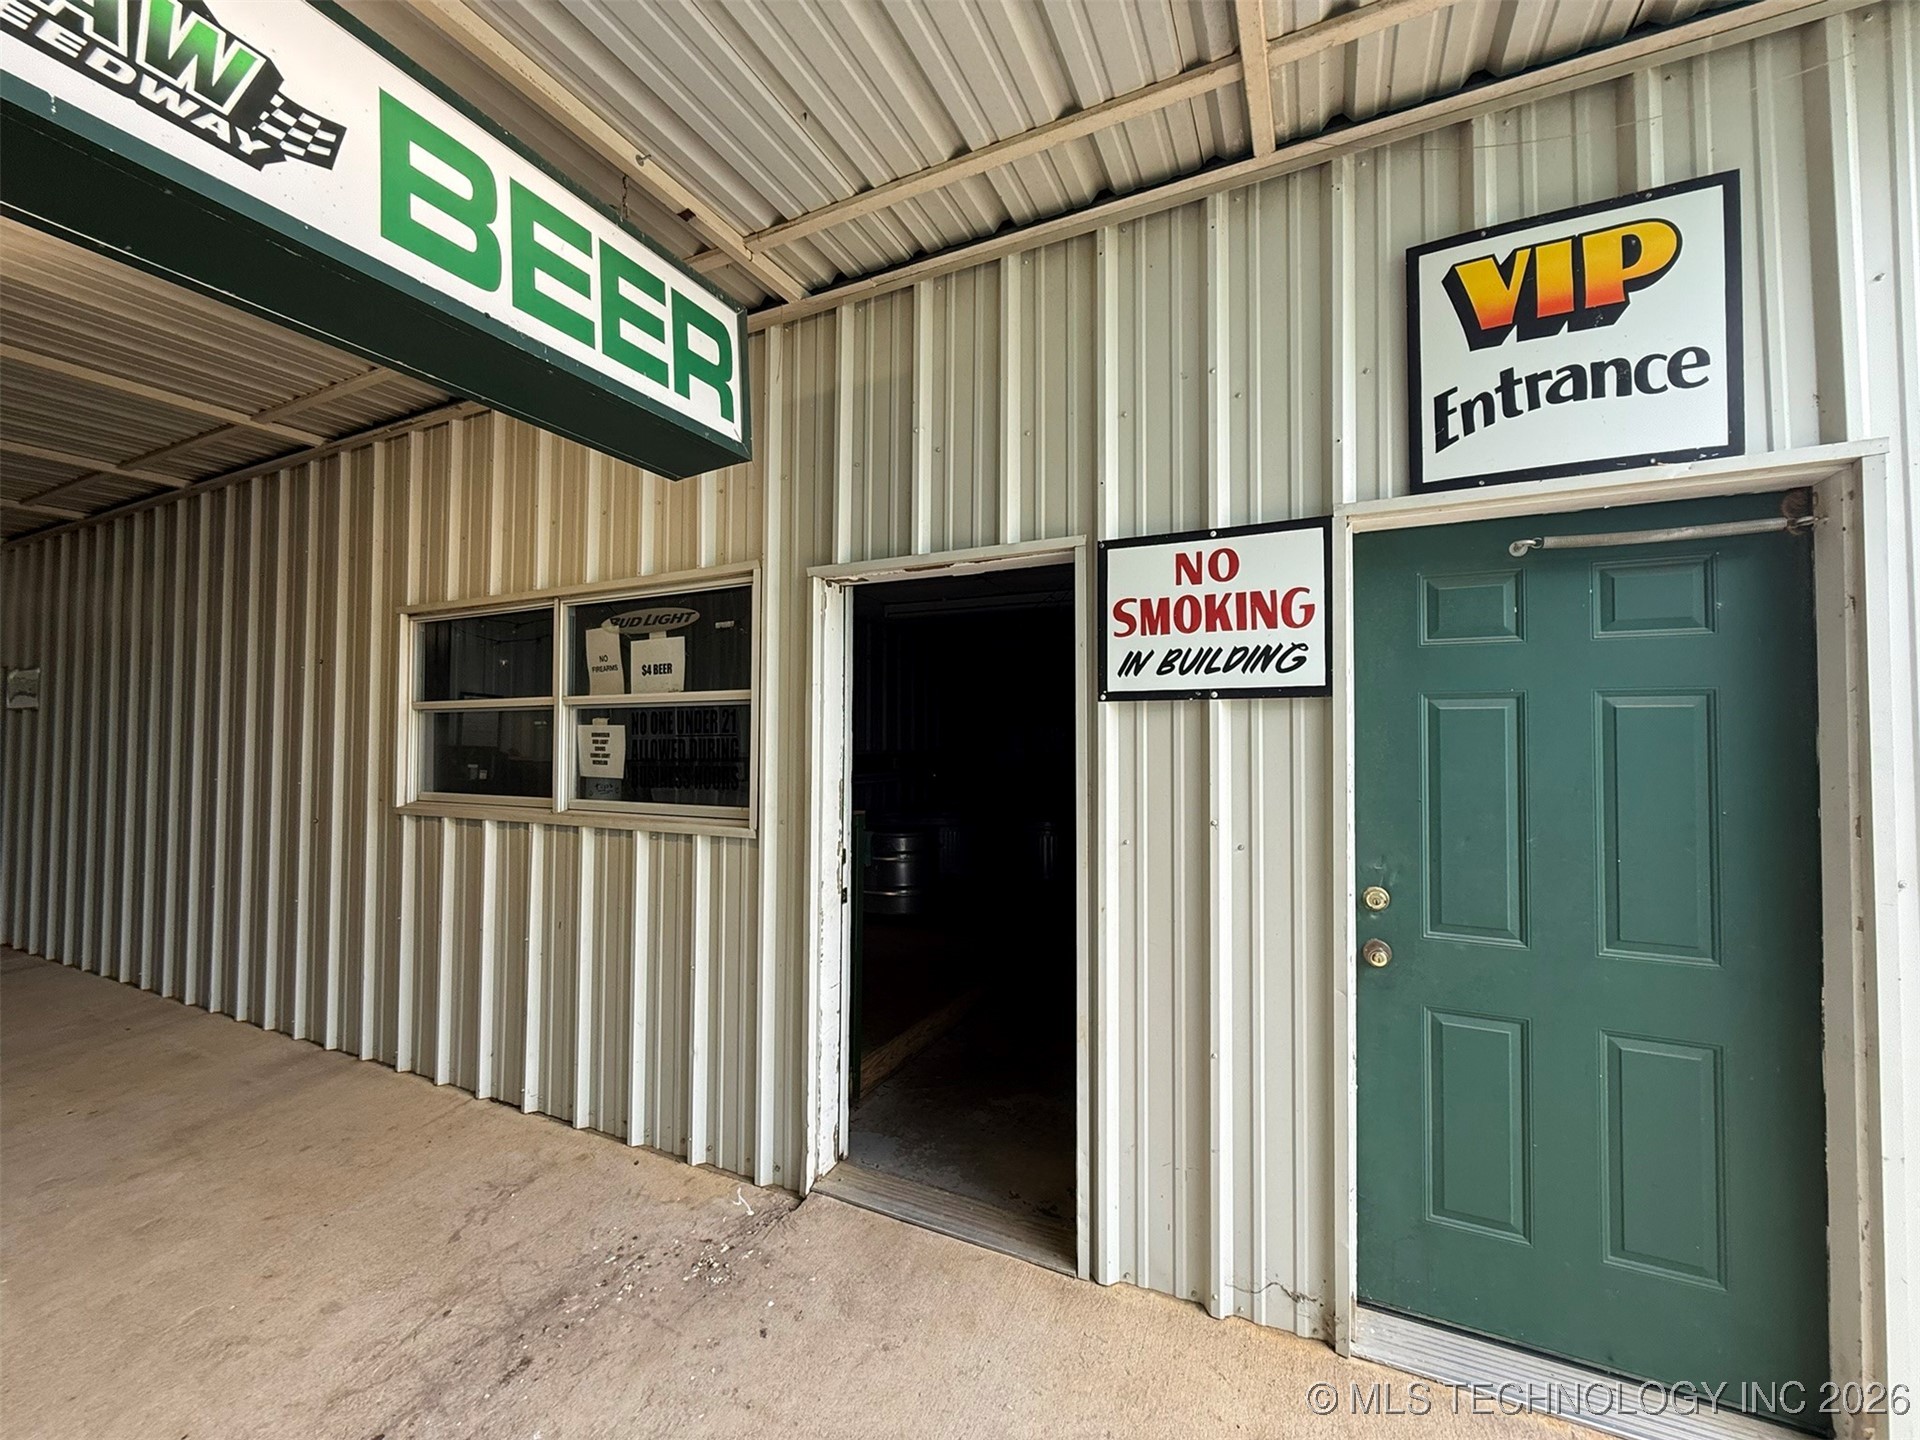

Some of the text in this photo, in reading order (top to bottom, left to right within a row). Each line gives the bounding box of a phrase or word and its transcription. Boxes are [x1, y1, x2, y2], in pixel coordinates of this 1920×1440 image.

[379, 87, 736, 424] BEER
[1441, 217, 1683, 352] VIP
[1433, 346, 1711, 454] Entrance
[1175, 548, 1240, 586] NO
[643, 611, 696, 626] LIGHT
[1112, 587, 1316, 638] SMOKING
[592, 664, 618, 673] FIREARMS
[599, 654, 608, 662] NO
[641, 663, 673, 677] $4 BEER
[1117, 642, 1309, 678] IN BUILDING
[632, 709, 737, 735] NO ONE UNDER 21
[632, 738, 739, 762] ALLOWED DURING
